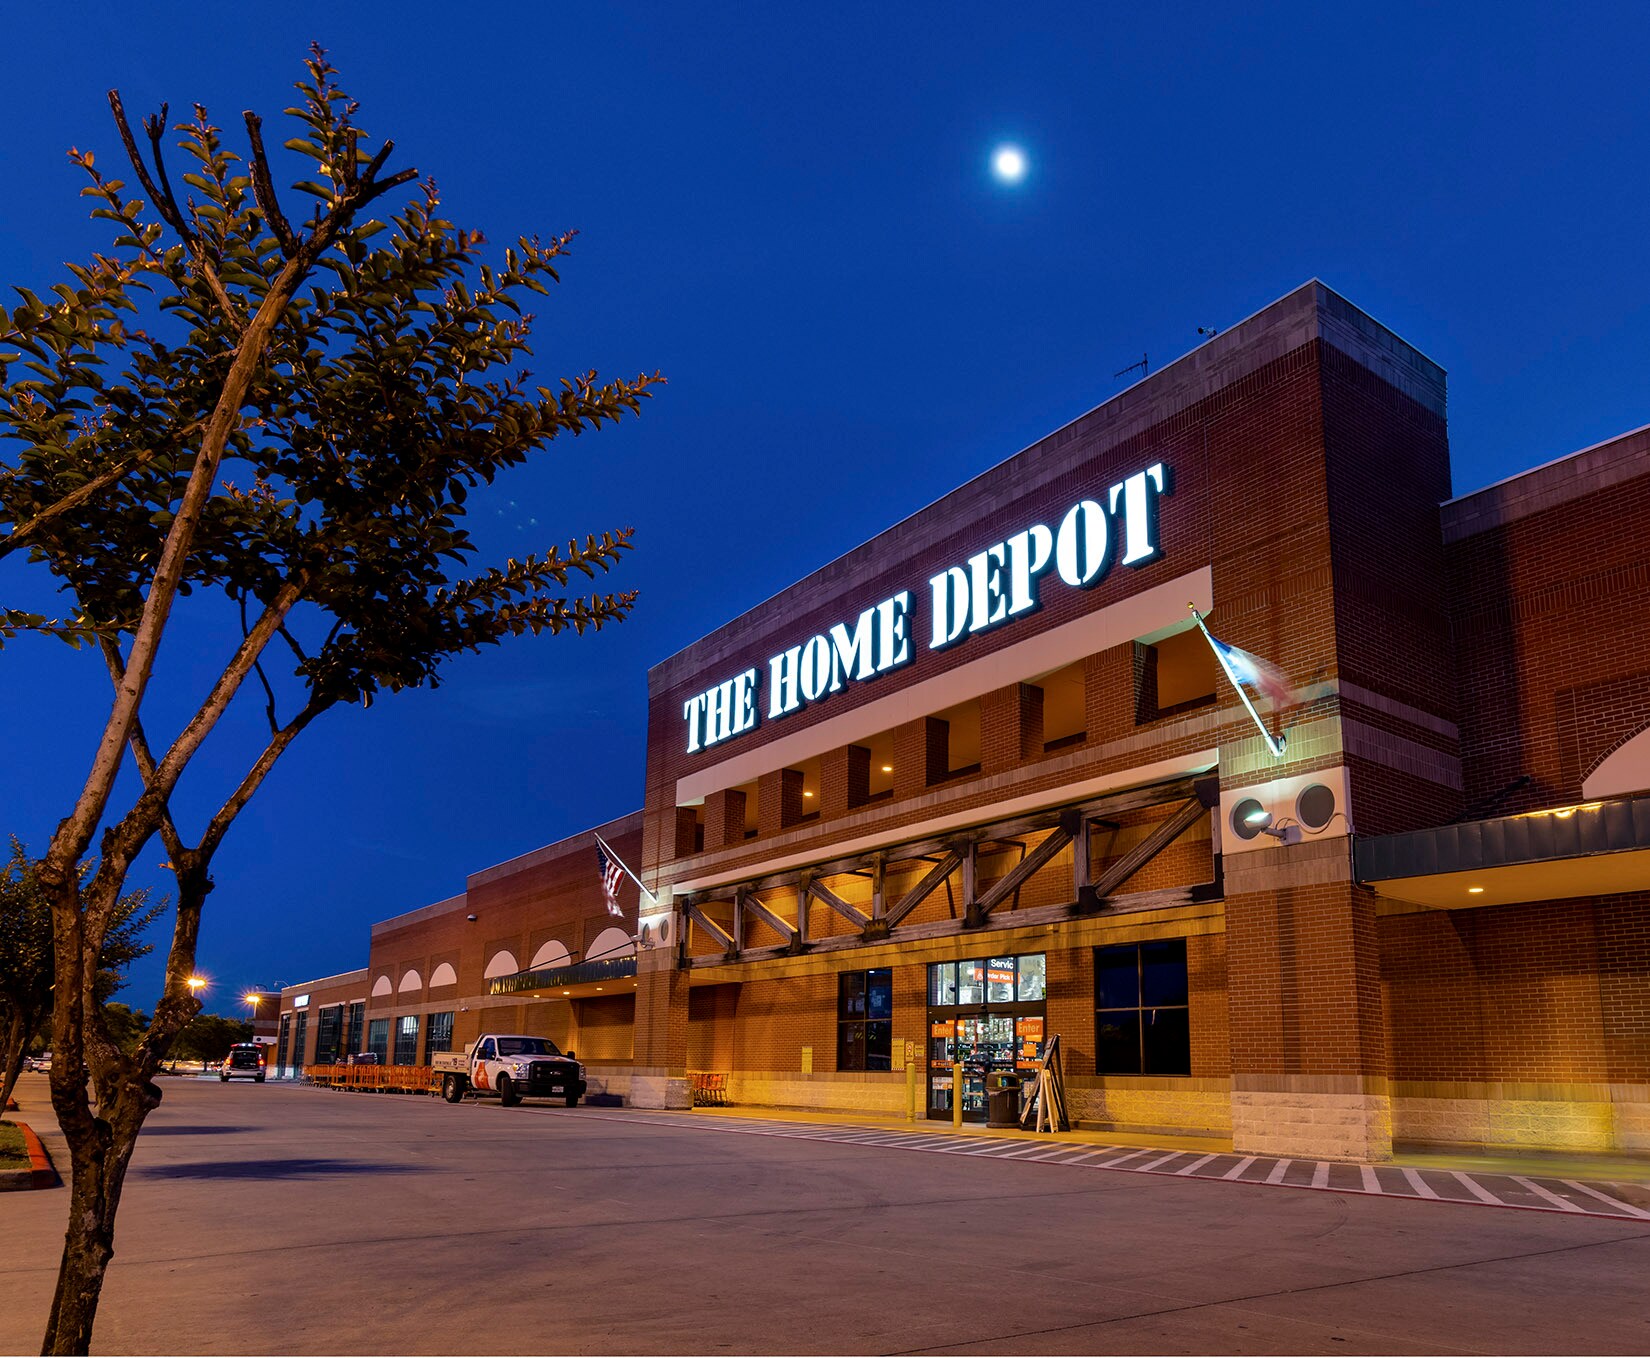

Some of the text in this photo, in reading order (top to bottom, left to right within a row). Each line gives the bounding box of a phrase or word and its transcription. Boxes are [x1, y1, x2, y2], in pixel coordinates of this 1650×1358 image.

[684, 462, 1164, 754] THE HOME DEPOT
[990, 959, 1014, 969] Servic
[934, 1025, 953, 1035] Enter
[1018, 1022, 1040, 1033] Enter
